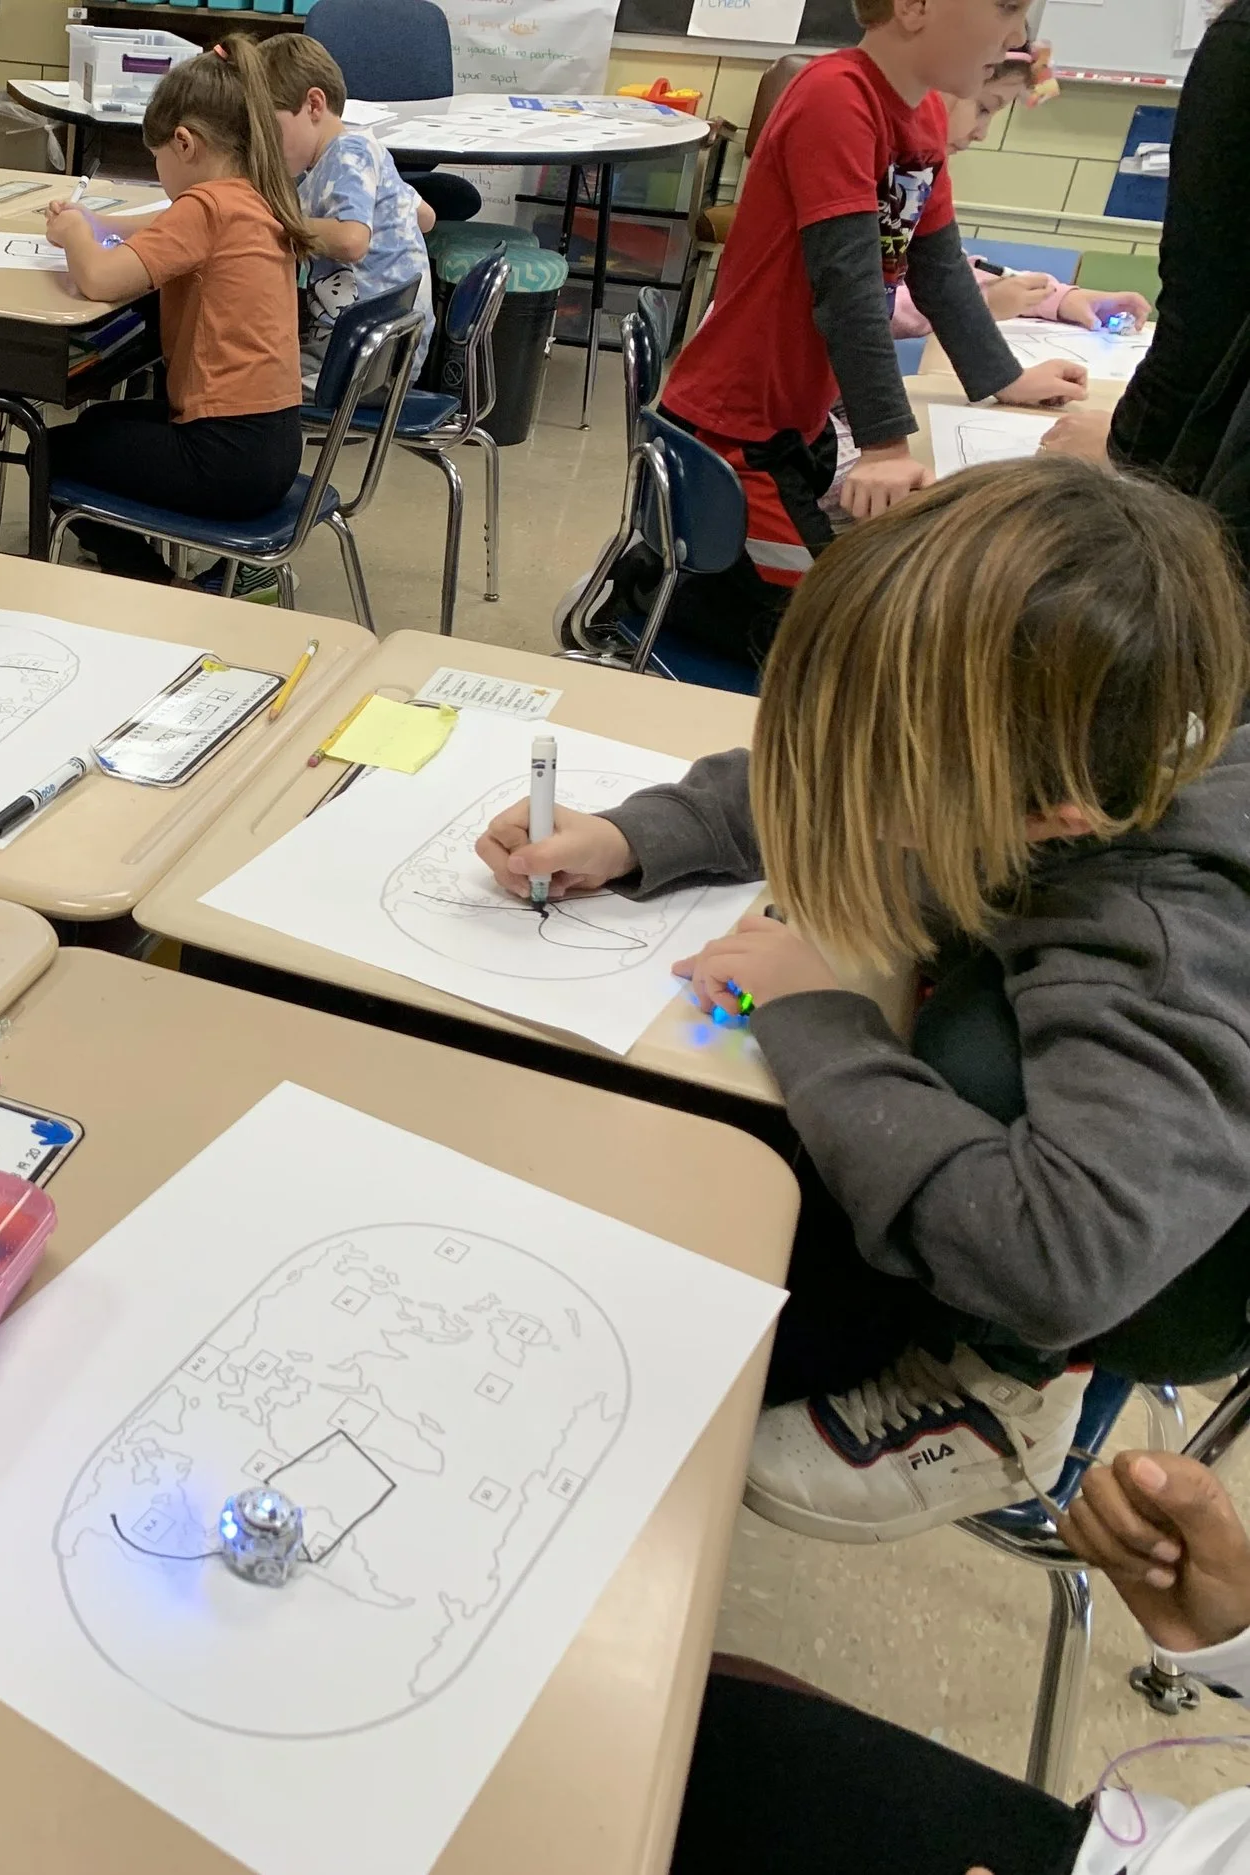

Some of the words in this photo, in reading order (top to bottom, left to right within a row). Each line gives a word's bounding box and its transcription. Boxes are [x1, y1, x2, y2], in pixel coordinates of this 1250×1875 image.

[509, 16, 540, 33] desk
[457, 71, 482, 84] your
[491, 70, 519, 86] spot
[26, 1147, 41, 1161] 20
[908, 1442, 956, 1471] FILA
